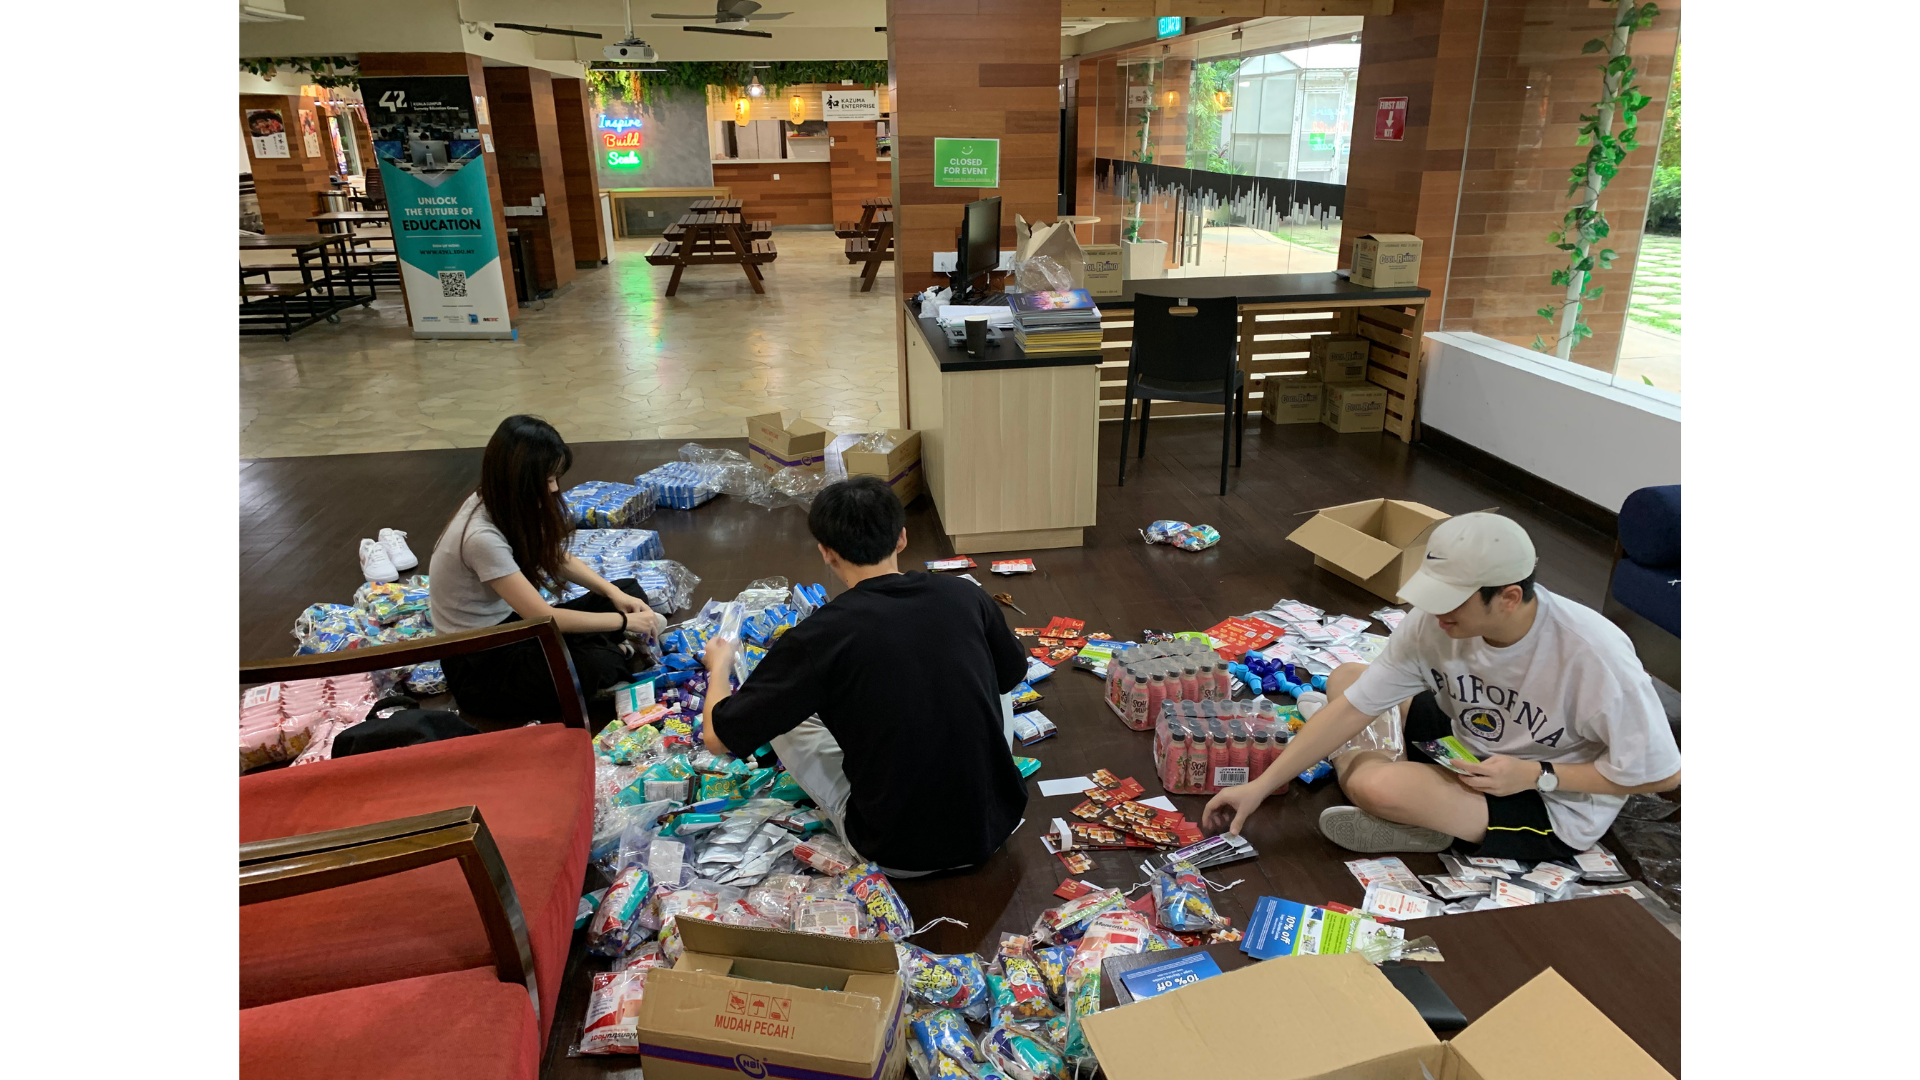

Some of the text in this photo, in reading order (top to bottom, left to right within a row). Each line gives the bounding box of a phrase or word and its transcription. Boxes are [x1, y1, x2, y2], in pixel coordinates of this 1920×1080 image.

[378, 91, 408, 112] 42
[1379, 101, 1406, 110] FIRST AID
[598, 114, 643, 133] Inspire
[1384, 128, 1394, 137] KIT
[603, 132, 641, 148] Build
[950, 158, 983, 166] CLOSED
[944, 166, 960, 174] FOR
[418, 196, 458, 205] UNLOCK
[402, 219, 482, 231] EDUCATION
[1380, 254, 1396, 264] COOL
[1346, 403, 1363, 412] COOL
[1132, 700, 1147, 708] SOY
[1191, 761, 1206, 770] SOY
[1284, 915, 1296, 932] 10%
[1280, 930, 1290, 945] off
[1156, 974, 1199, 992] 10% off
[714, 1014, 795, 1039] MUDAH PECAH !
[590, 1032, 637, 1042] MenstruHeat
